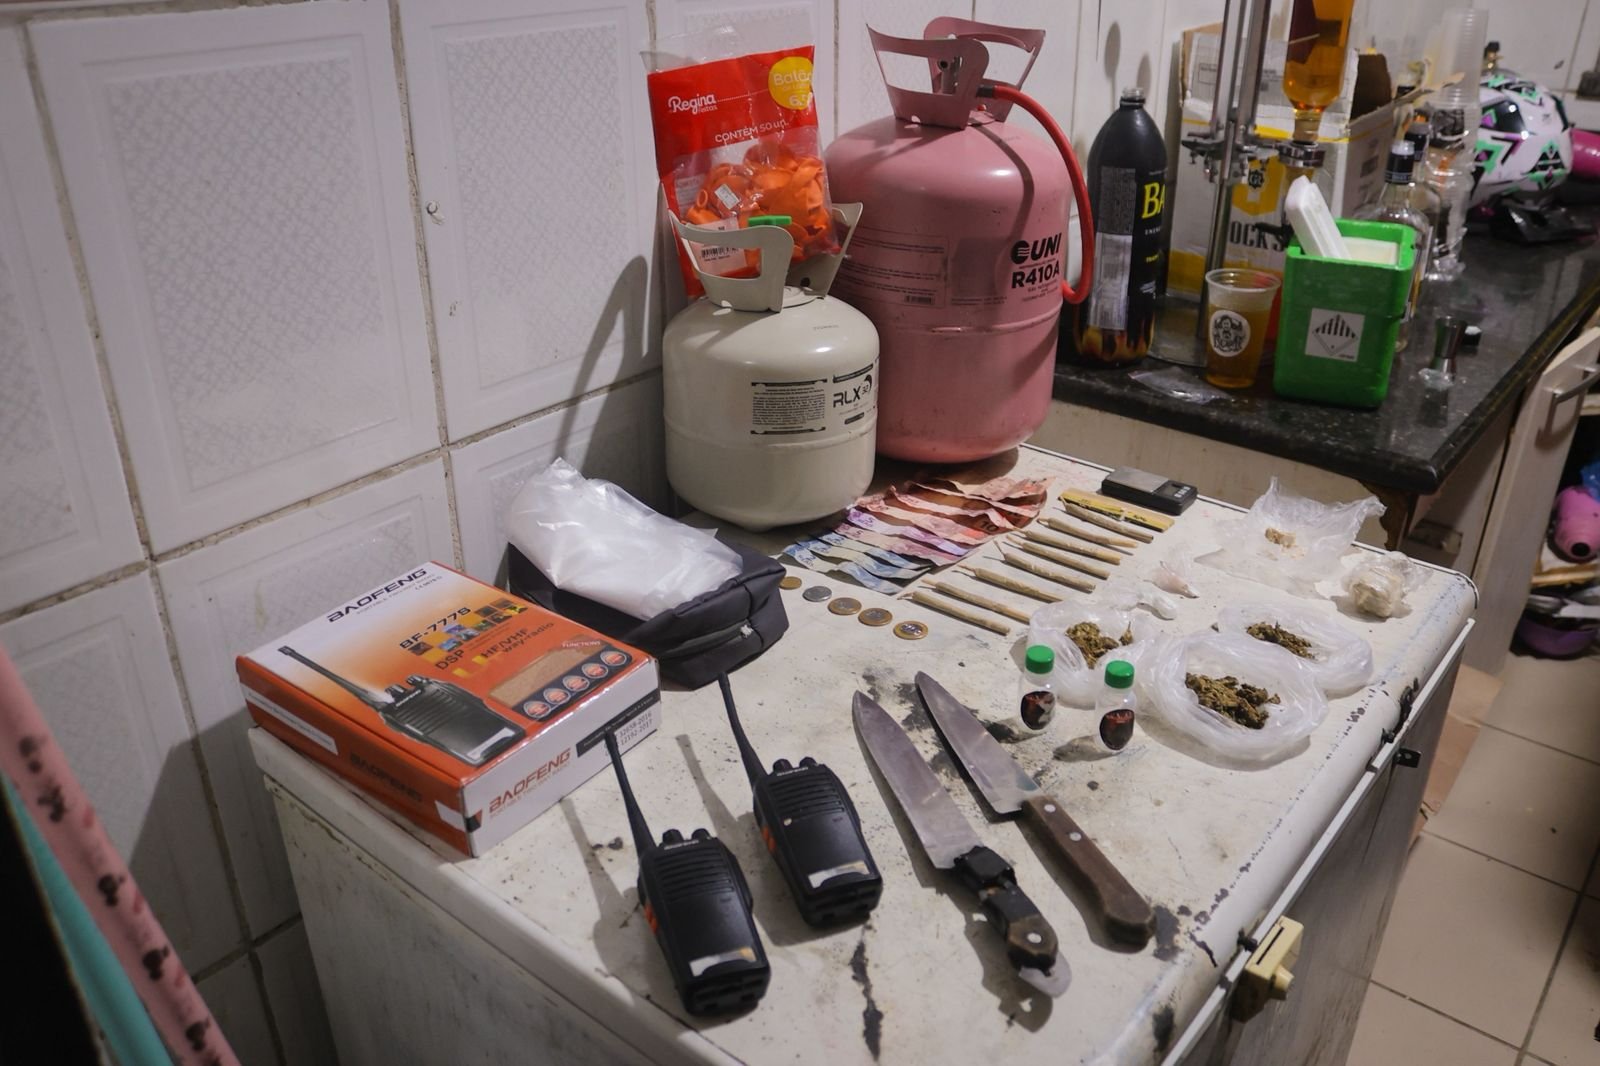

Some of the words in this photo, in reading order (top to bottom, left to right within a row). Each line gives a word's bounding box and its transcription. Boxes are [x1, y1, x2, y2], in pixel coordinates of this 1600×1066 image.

[668, 93, 717, 115] Regina
[714, 126, 759, 143] CONTÉM
[759, 122, 773, 133] 50
[1011, 260, 1060, 289] R410A
[833, 385, 861, 408] RLX
[326, 568, 427, 623] BAOFENG
[435, 649, 467, 671] DSP
[488, 747, 572, 813] BAOFENG
